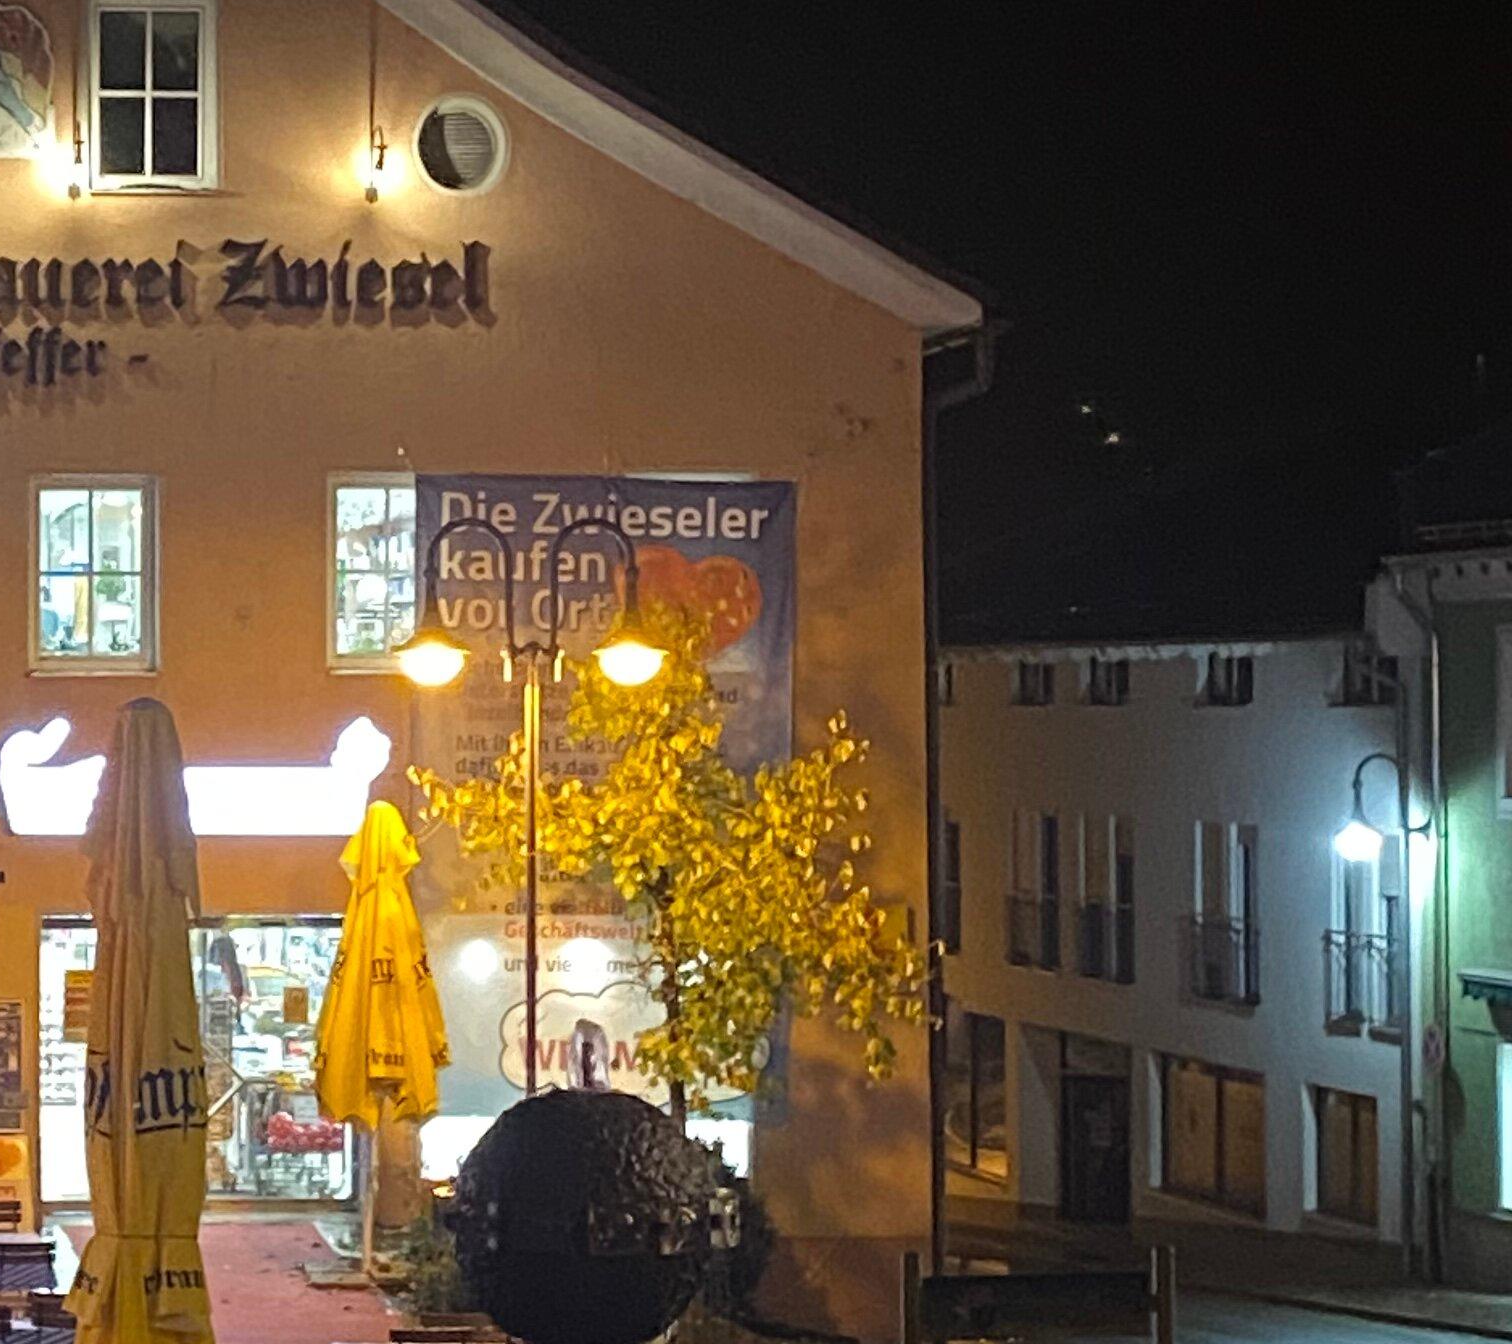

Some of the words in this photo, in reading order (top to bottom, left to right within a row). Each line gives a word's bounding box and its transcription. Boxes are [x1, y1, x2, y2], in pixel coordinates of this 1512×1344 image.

[216, 238, 491, 309] Zwiesel
[440, 491, 517, 535] Die
[531, 492, 769, 540] Zwieseler
[439, 539, 607, 582] kaufen
[531, 588, 610, 632] Ort
